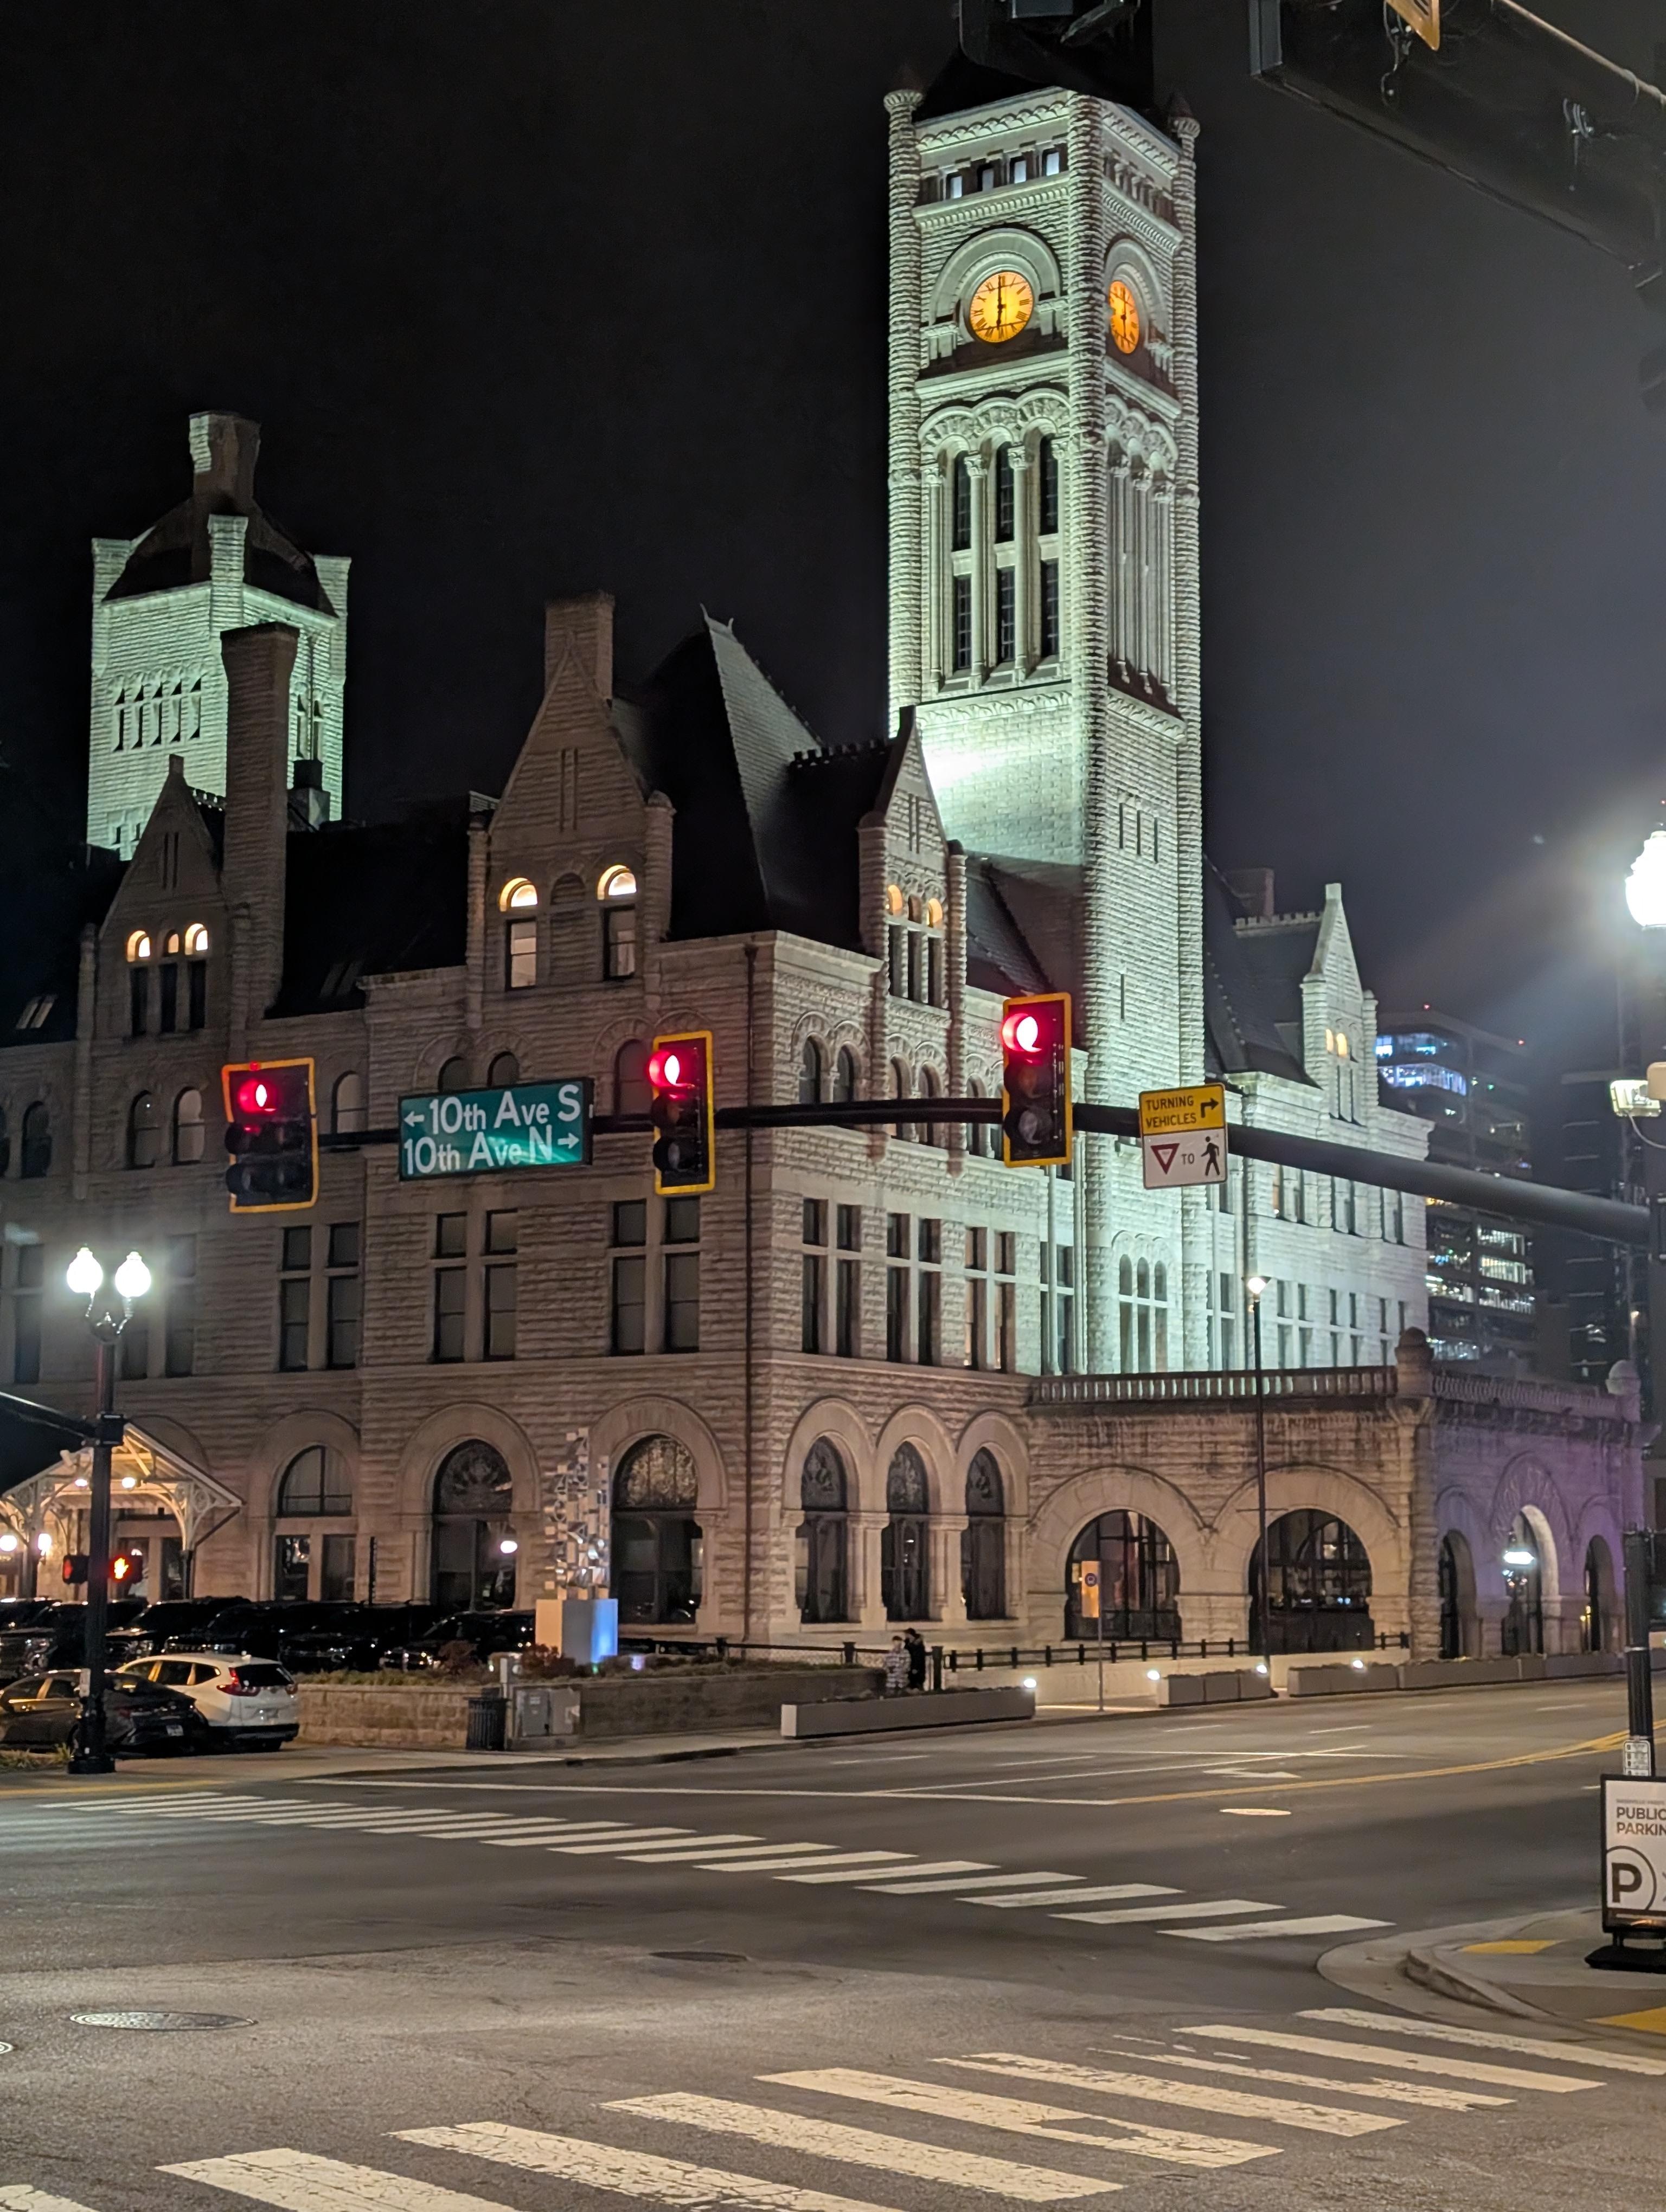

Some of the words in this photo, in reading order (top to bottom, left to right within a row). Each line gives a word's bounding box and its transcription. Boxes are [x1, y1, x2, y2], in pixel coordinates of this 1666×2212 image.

[430, 1097, 486, 1134] 10th
[494, 1091, 550, 1129] Ave
[558, 1084, 581, 1122] S
[1146, 1096, 1194, 1111] TURNING
[1146, 1113, 1197, 1128] VEHICLES
[404, 1137, 460, 1175] 10th
[467, 1131, 522, 1169] Ave
[529, 1124, 552, 1165] N
[1181, 1153, 1195, 1165] TO
[1612, 1862, 1642, 1903] P
